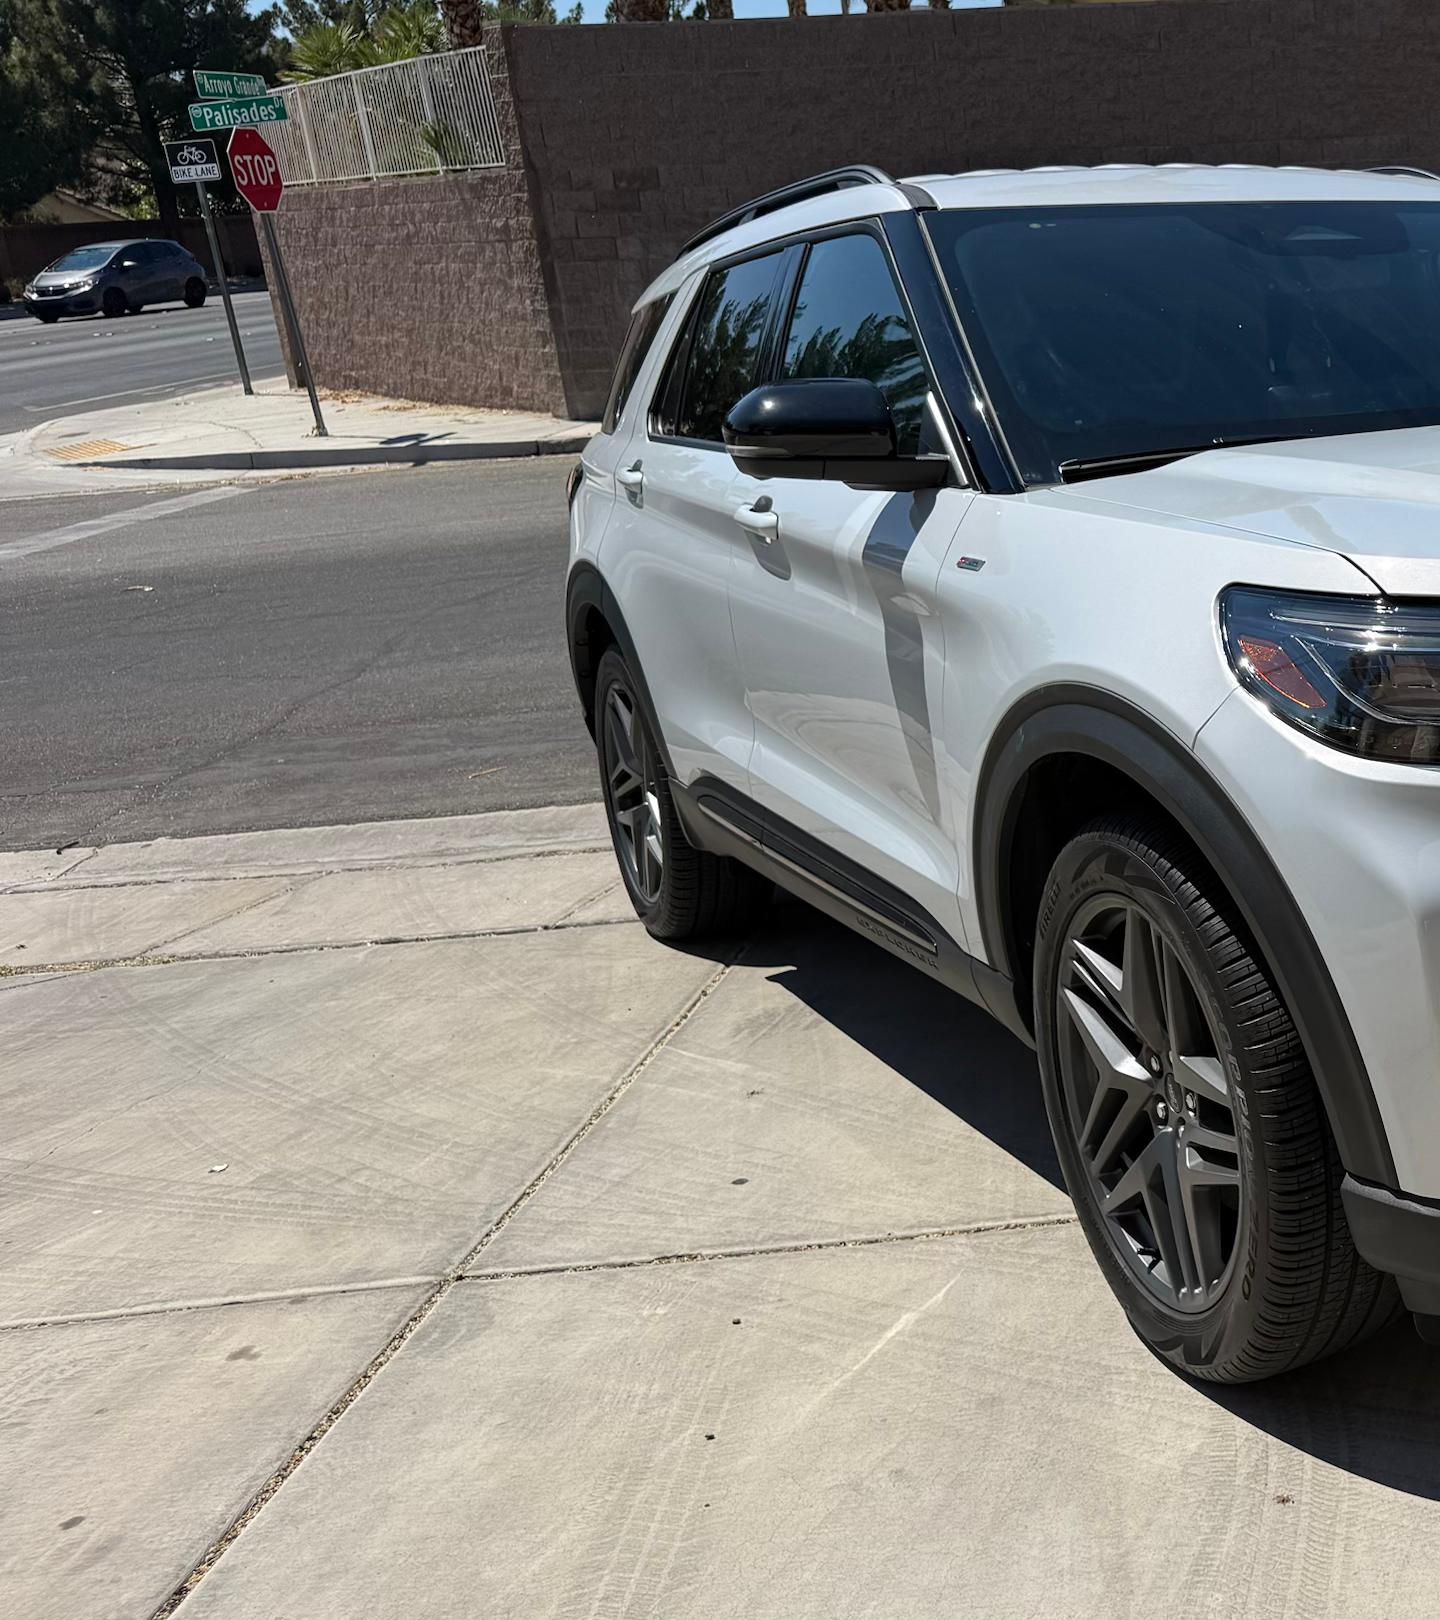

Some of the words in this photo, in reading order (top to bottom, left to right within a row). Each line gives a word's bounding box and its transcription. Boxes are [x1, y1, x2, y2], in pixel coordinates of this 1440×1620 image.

[204, 75, 233, 98] Arroyo
[234, 76, 260, 96] Grande
[203, 102, 277, 127] Palisades
[273, 97, 284, 108] Dr
[173, 167, 192, 179] BIKE
[195, 166, 218, 177] LANE
[234, 155, 276, 186] STOP
[1203, 972, 1257, 1183] CORPIO
